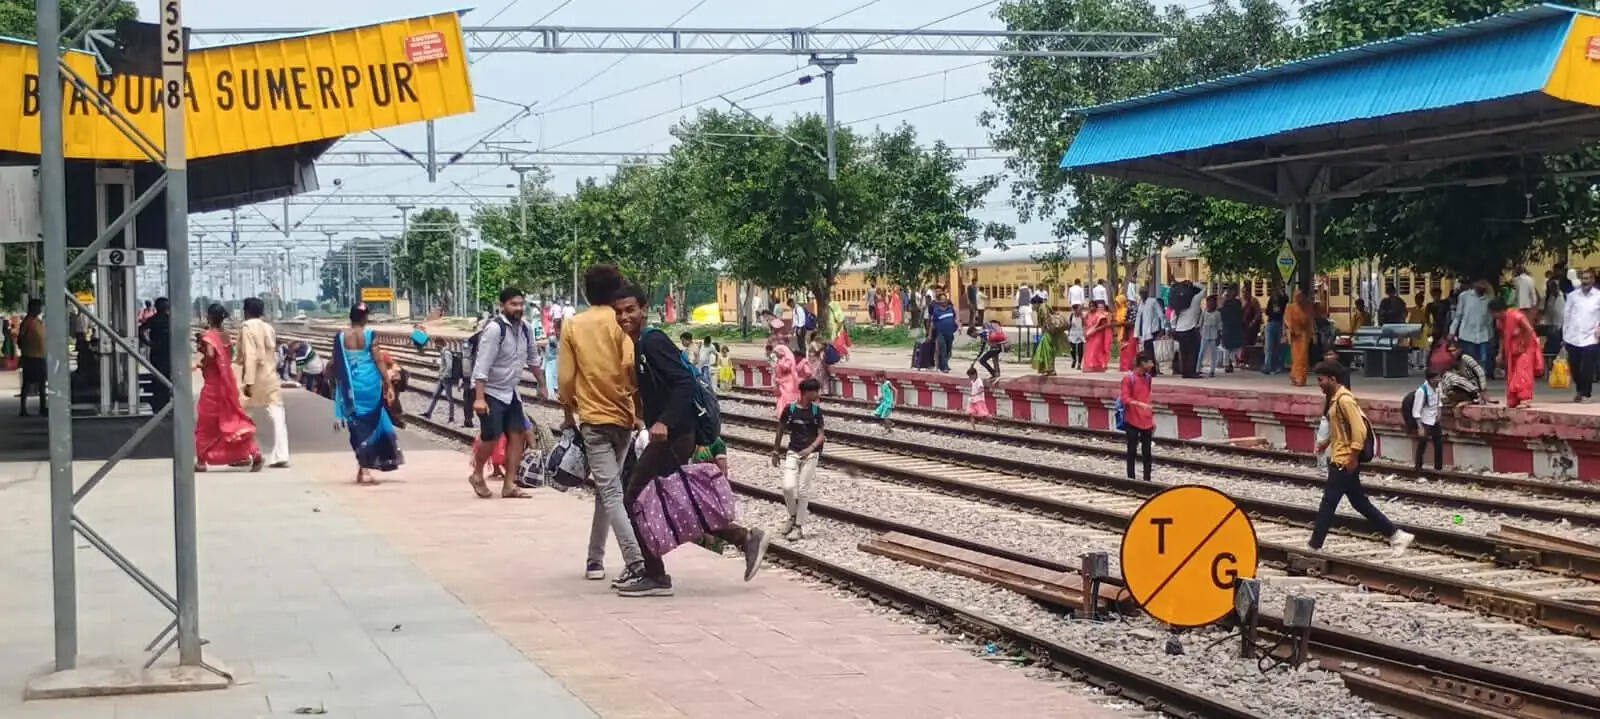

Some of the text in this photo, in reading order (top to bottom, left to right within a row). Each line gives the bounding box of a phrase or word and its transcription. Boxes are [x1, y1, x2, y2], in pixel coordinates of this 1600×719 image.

[23, 62, 419, 116] BARUWA SUMERPUR
[167, 80, 180, 109] 8
[1150, 518, 1173, 554] T
[1211, 552, 1238, 590] G
